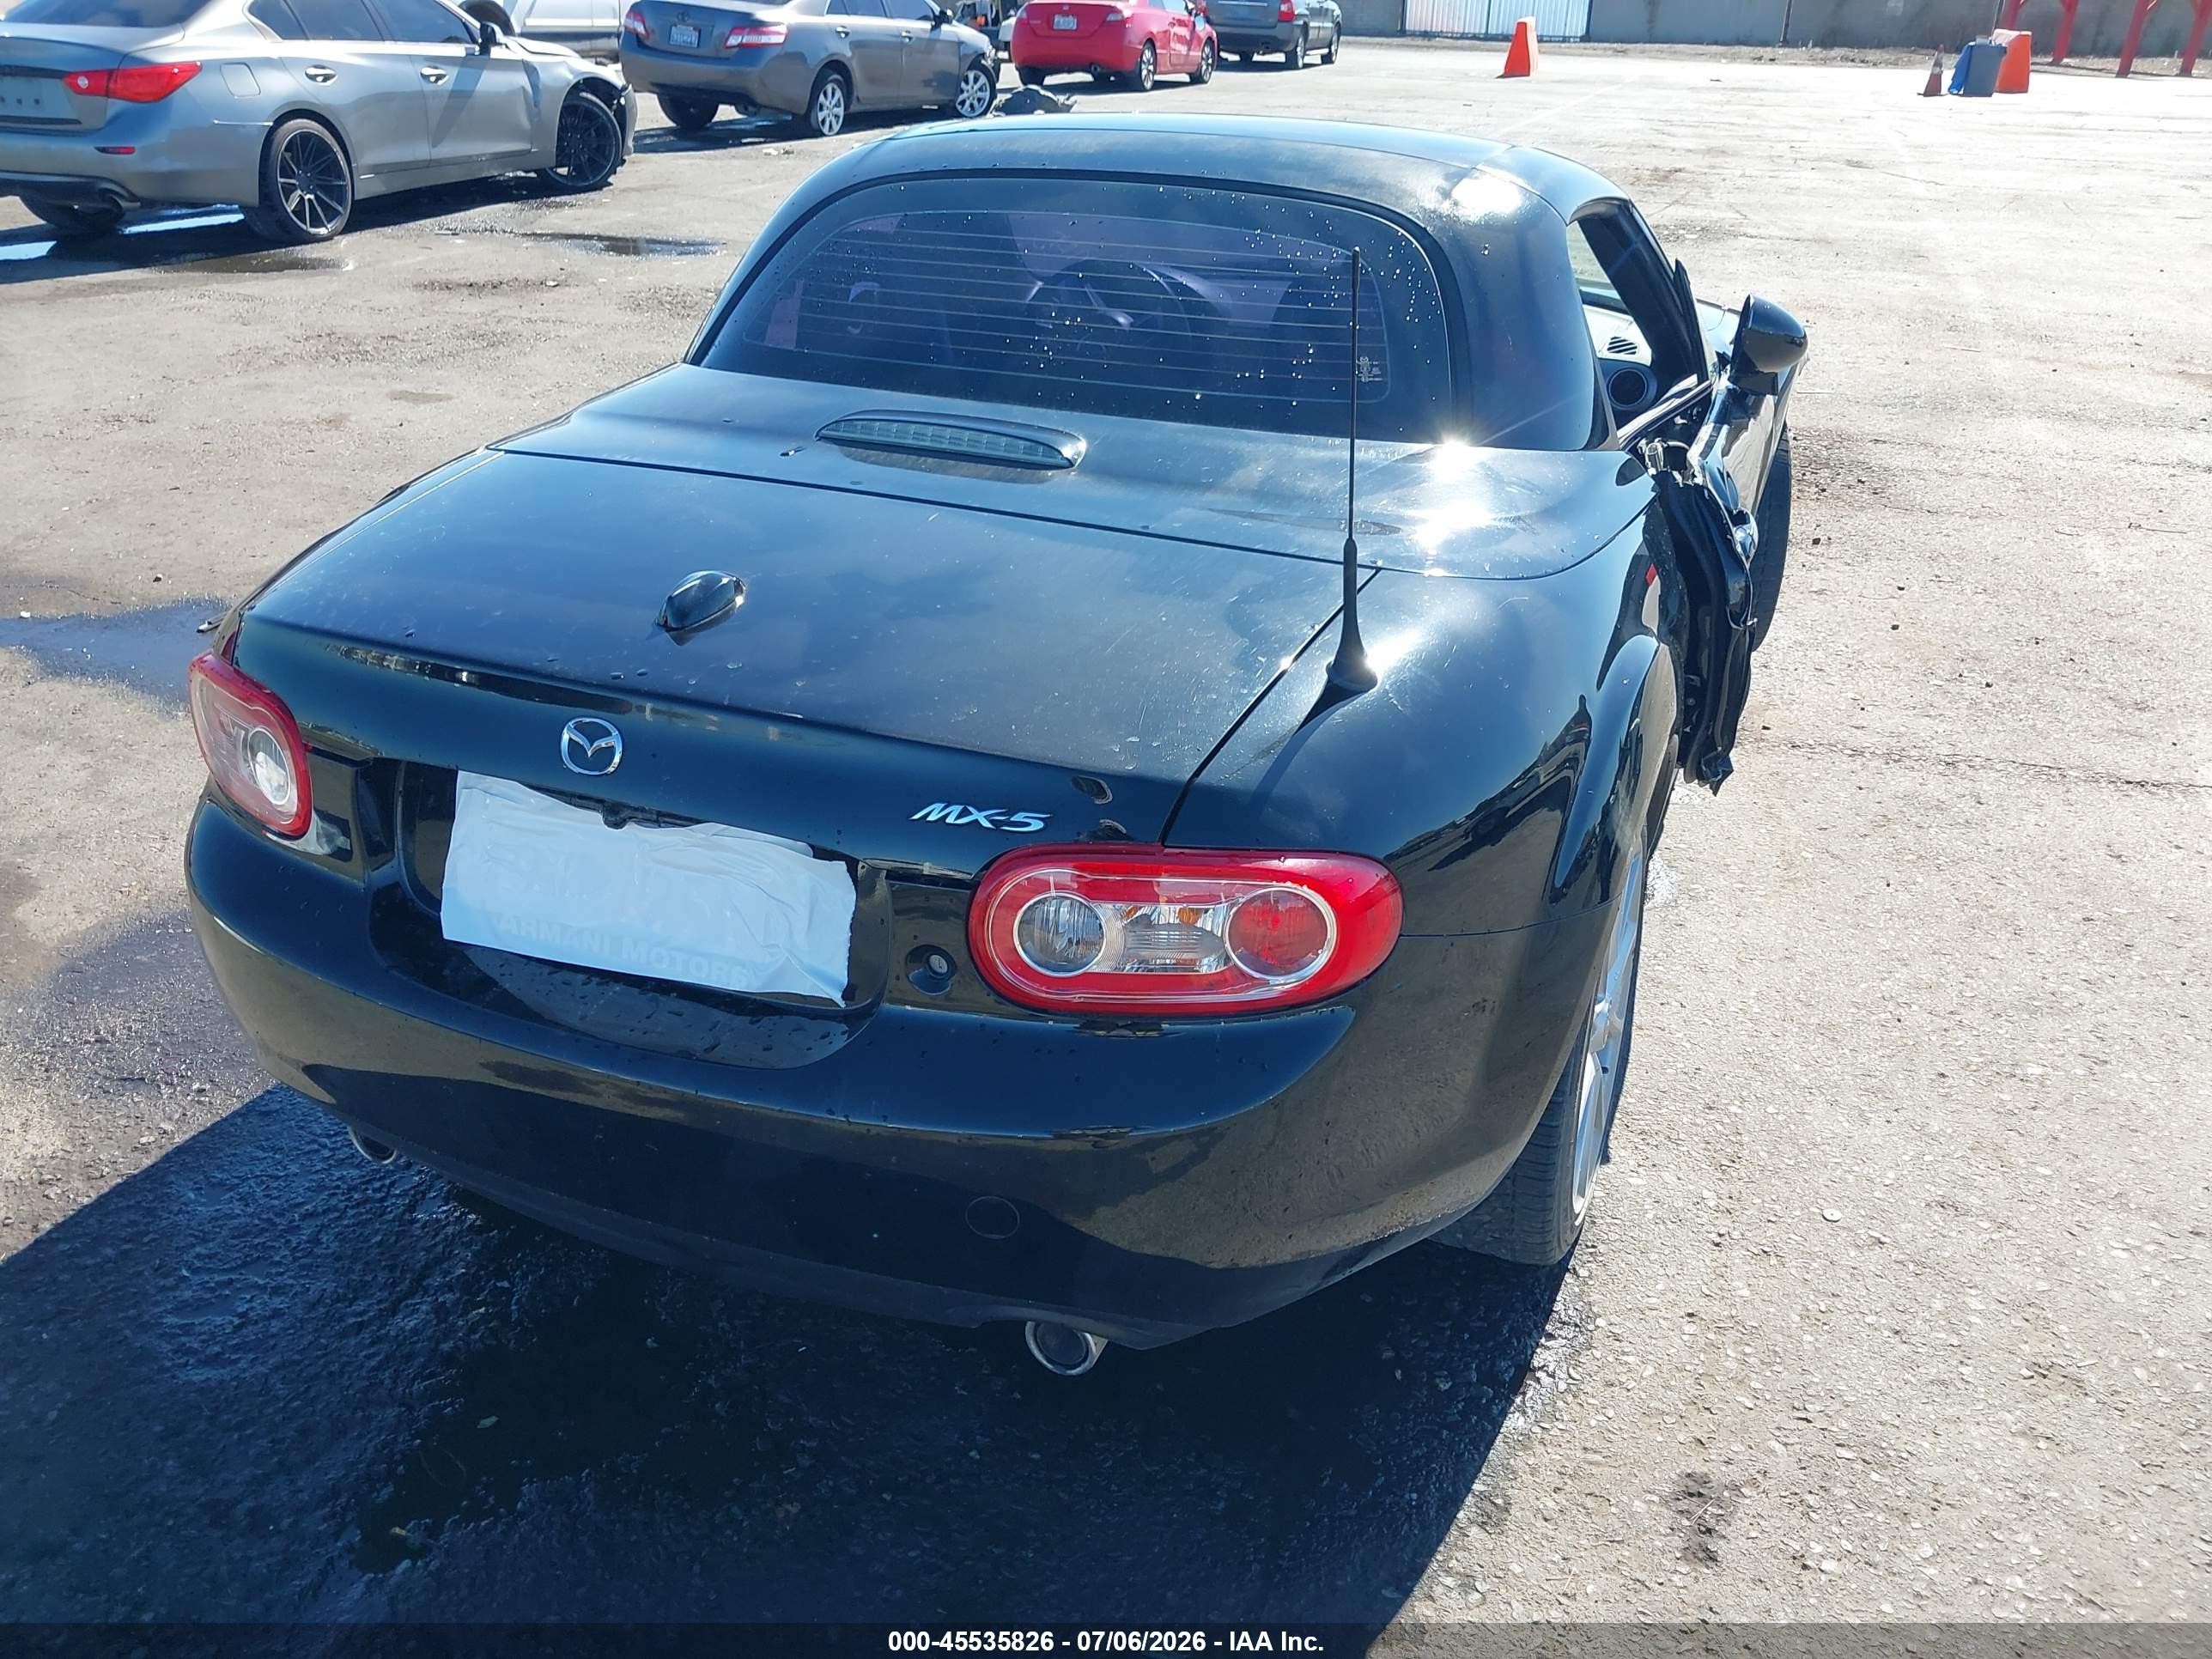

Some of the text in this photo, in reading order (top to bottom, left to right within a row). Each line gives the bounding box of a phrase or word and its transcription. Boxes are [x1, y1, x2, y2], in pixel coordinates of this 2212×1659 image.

[909, 803, 1051, 832] MX-5
[499, 914, 749, 988] ARMANI MOTORS
